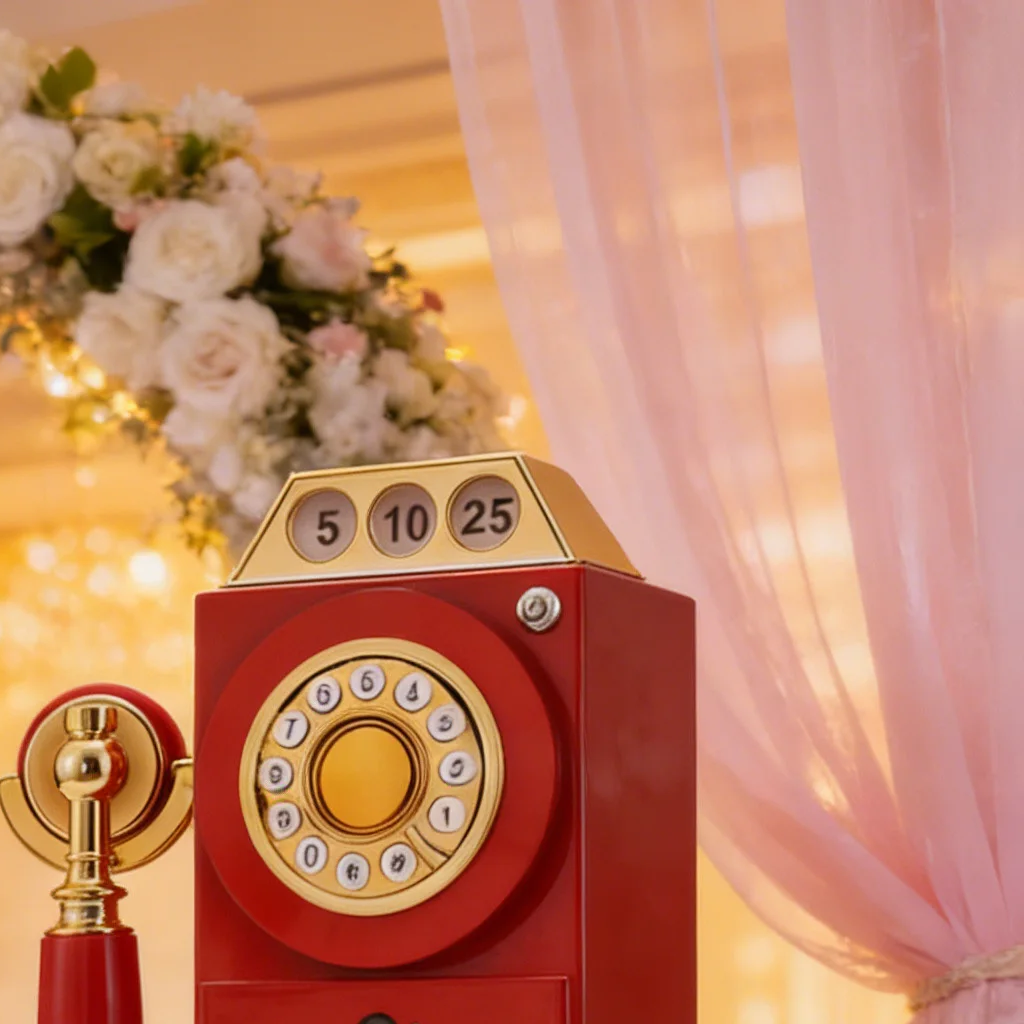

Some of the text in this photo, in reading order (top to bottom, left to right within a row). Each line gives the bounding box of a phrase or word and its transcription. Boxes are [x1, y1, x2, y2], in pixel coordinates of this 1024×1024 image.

[317, 498, 514, 546] 5 10 25
[441, 806, 450, 828] 1
